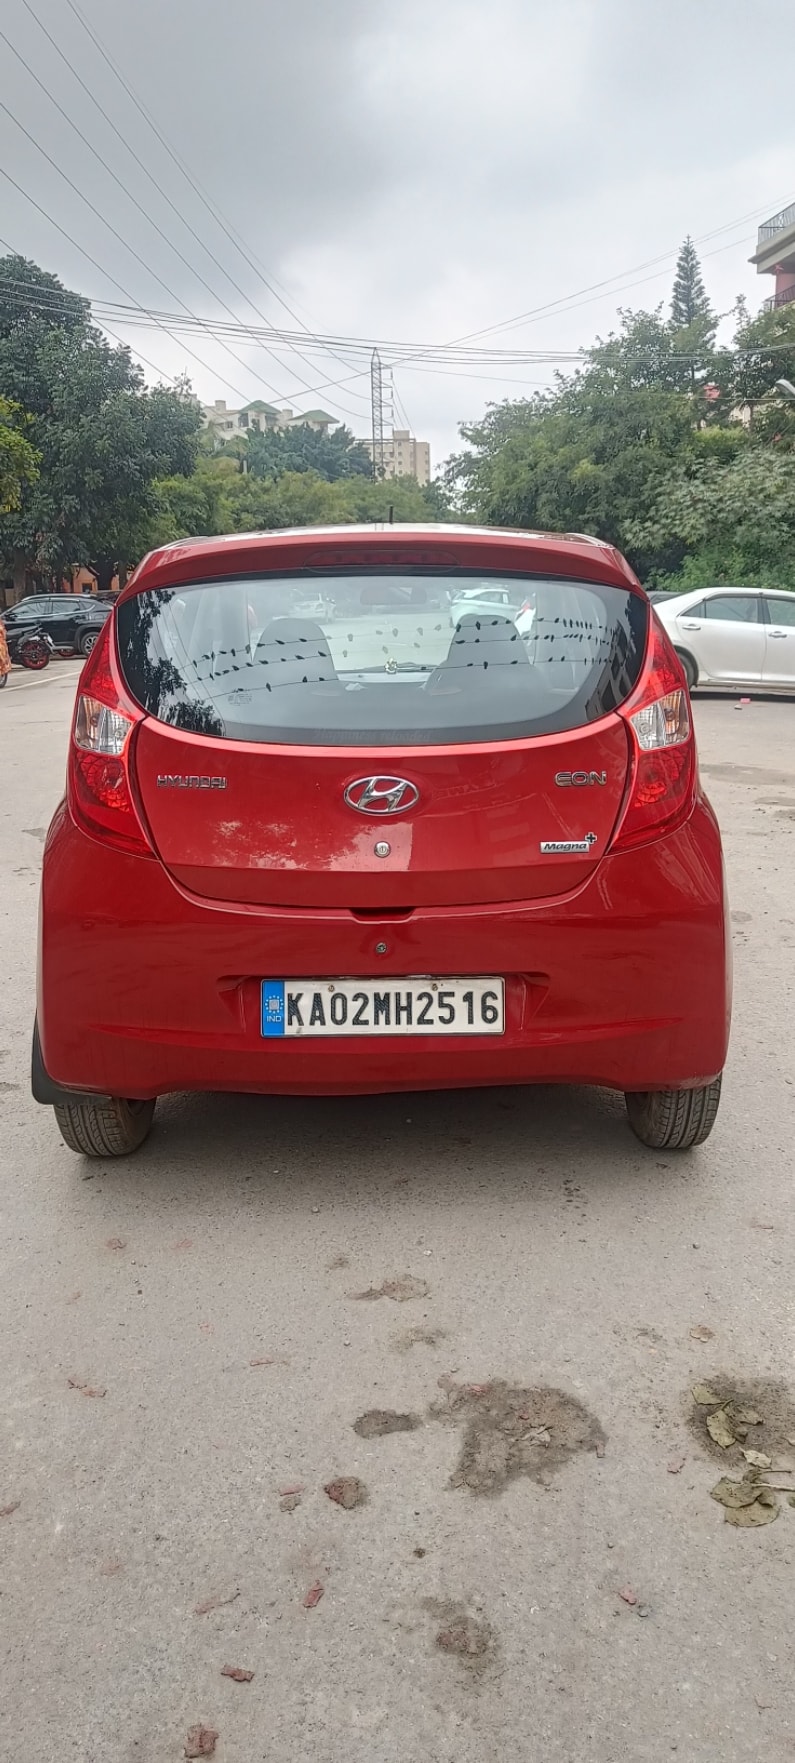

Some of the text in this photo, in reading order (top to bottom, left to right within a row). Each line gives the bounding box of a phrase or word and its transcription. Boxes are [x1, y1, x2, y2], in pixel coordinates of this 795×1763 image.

[157, 774, 227, 789] HYUNDAI
[555, 771, 607, 787] EON
[287, 991, 499, 1026] KA02MH2516
[266, 1015, 282, 1023] IND
